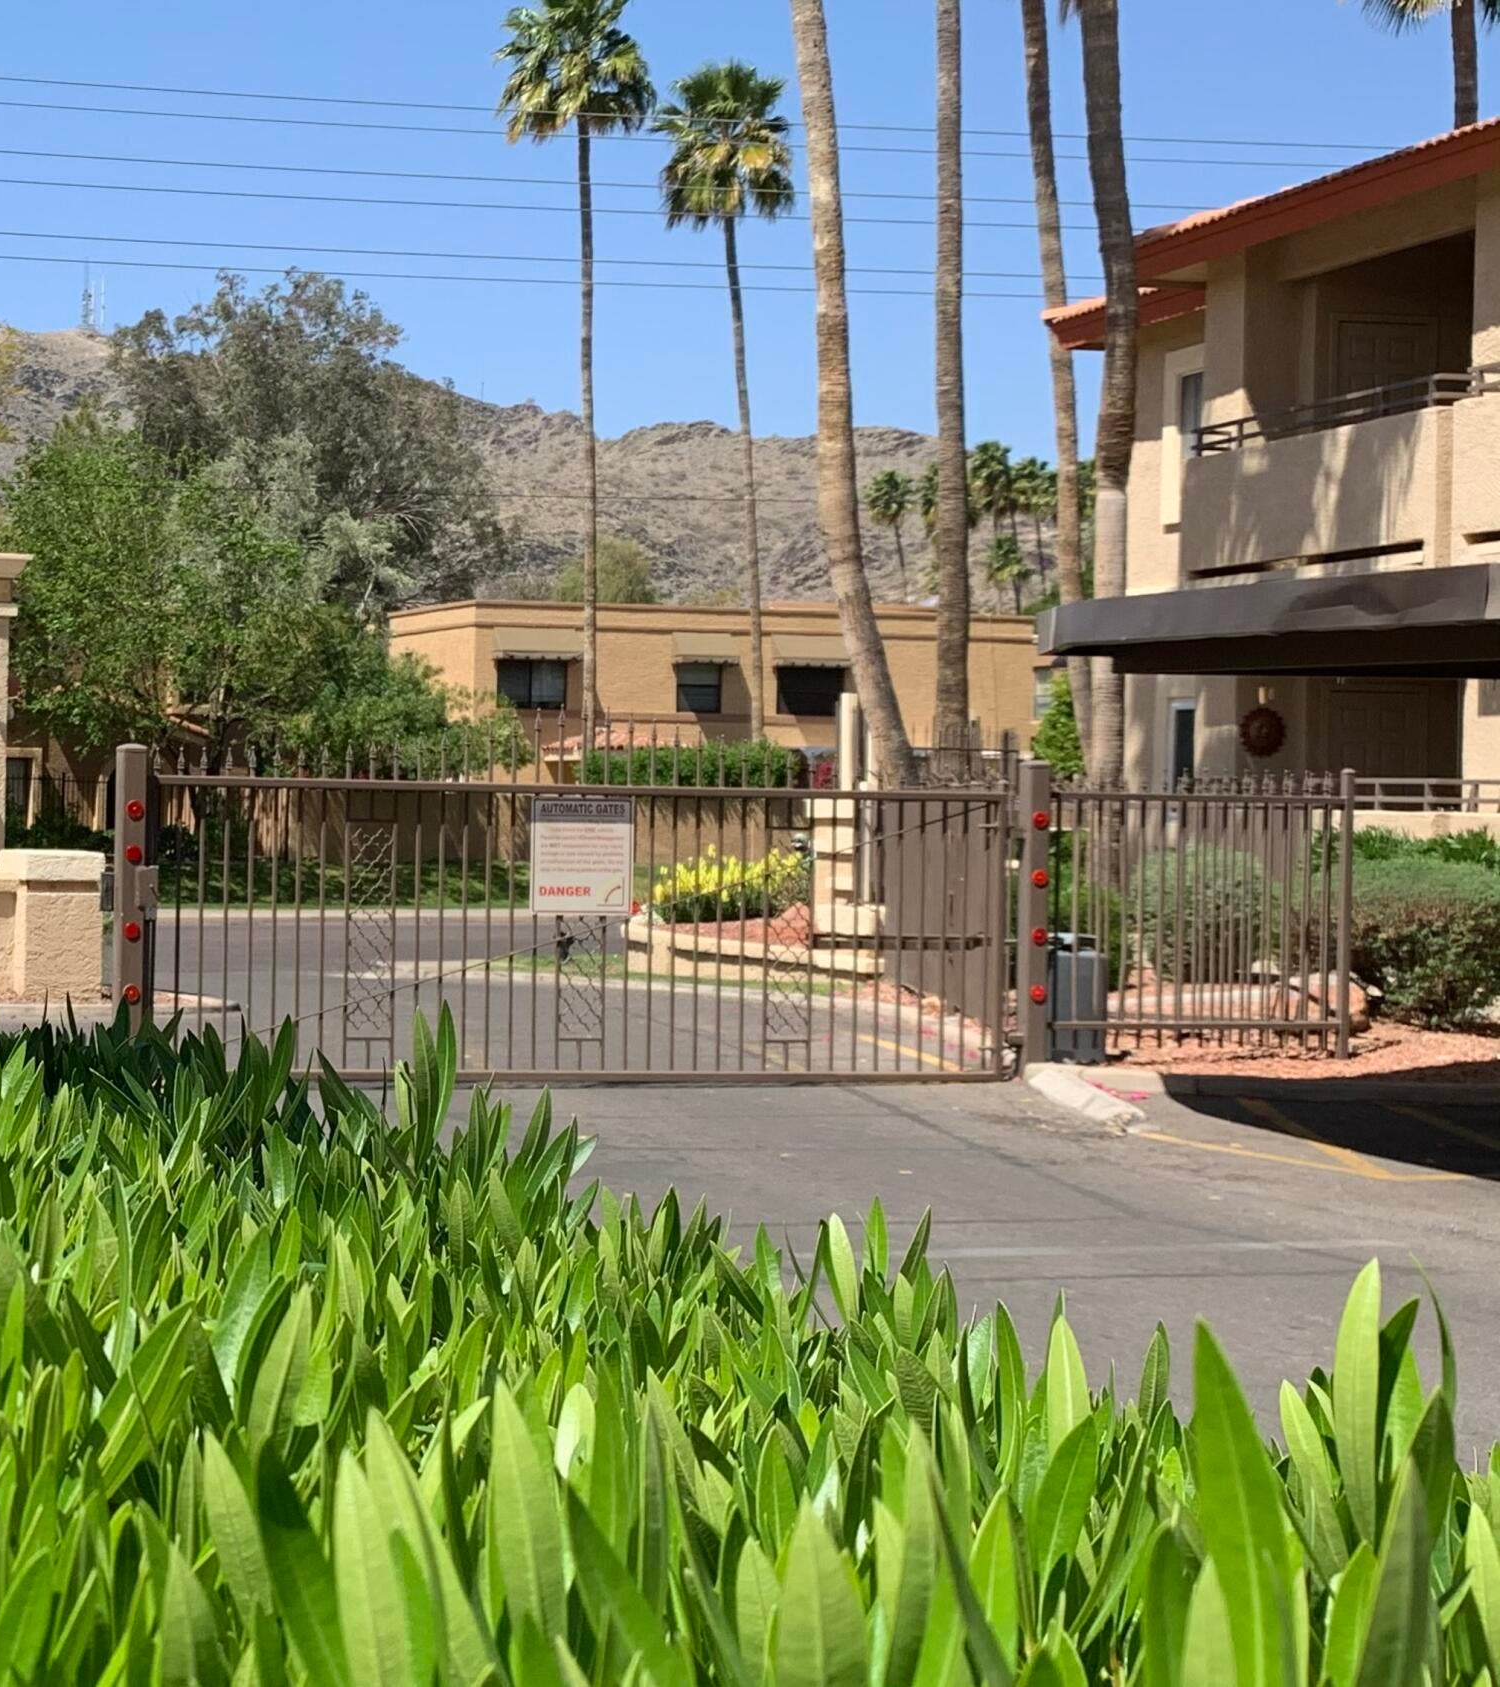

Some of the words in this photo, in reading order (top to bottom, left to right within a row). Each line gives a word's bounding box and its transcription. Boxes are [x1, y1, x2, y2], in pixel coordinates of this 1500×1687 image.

[541, 803, 593, 814] AUTOMATIC
[596, 803, 625, 814] GATES
[539, 886, 591, 897] DANGER
